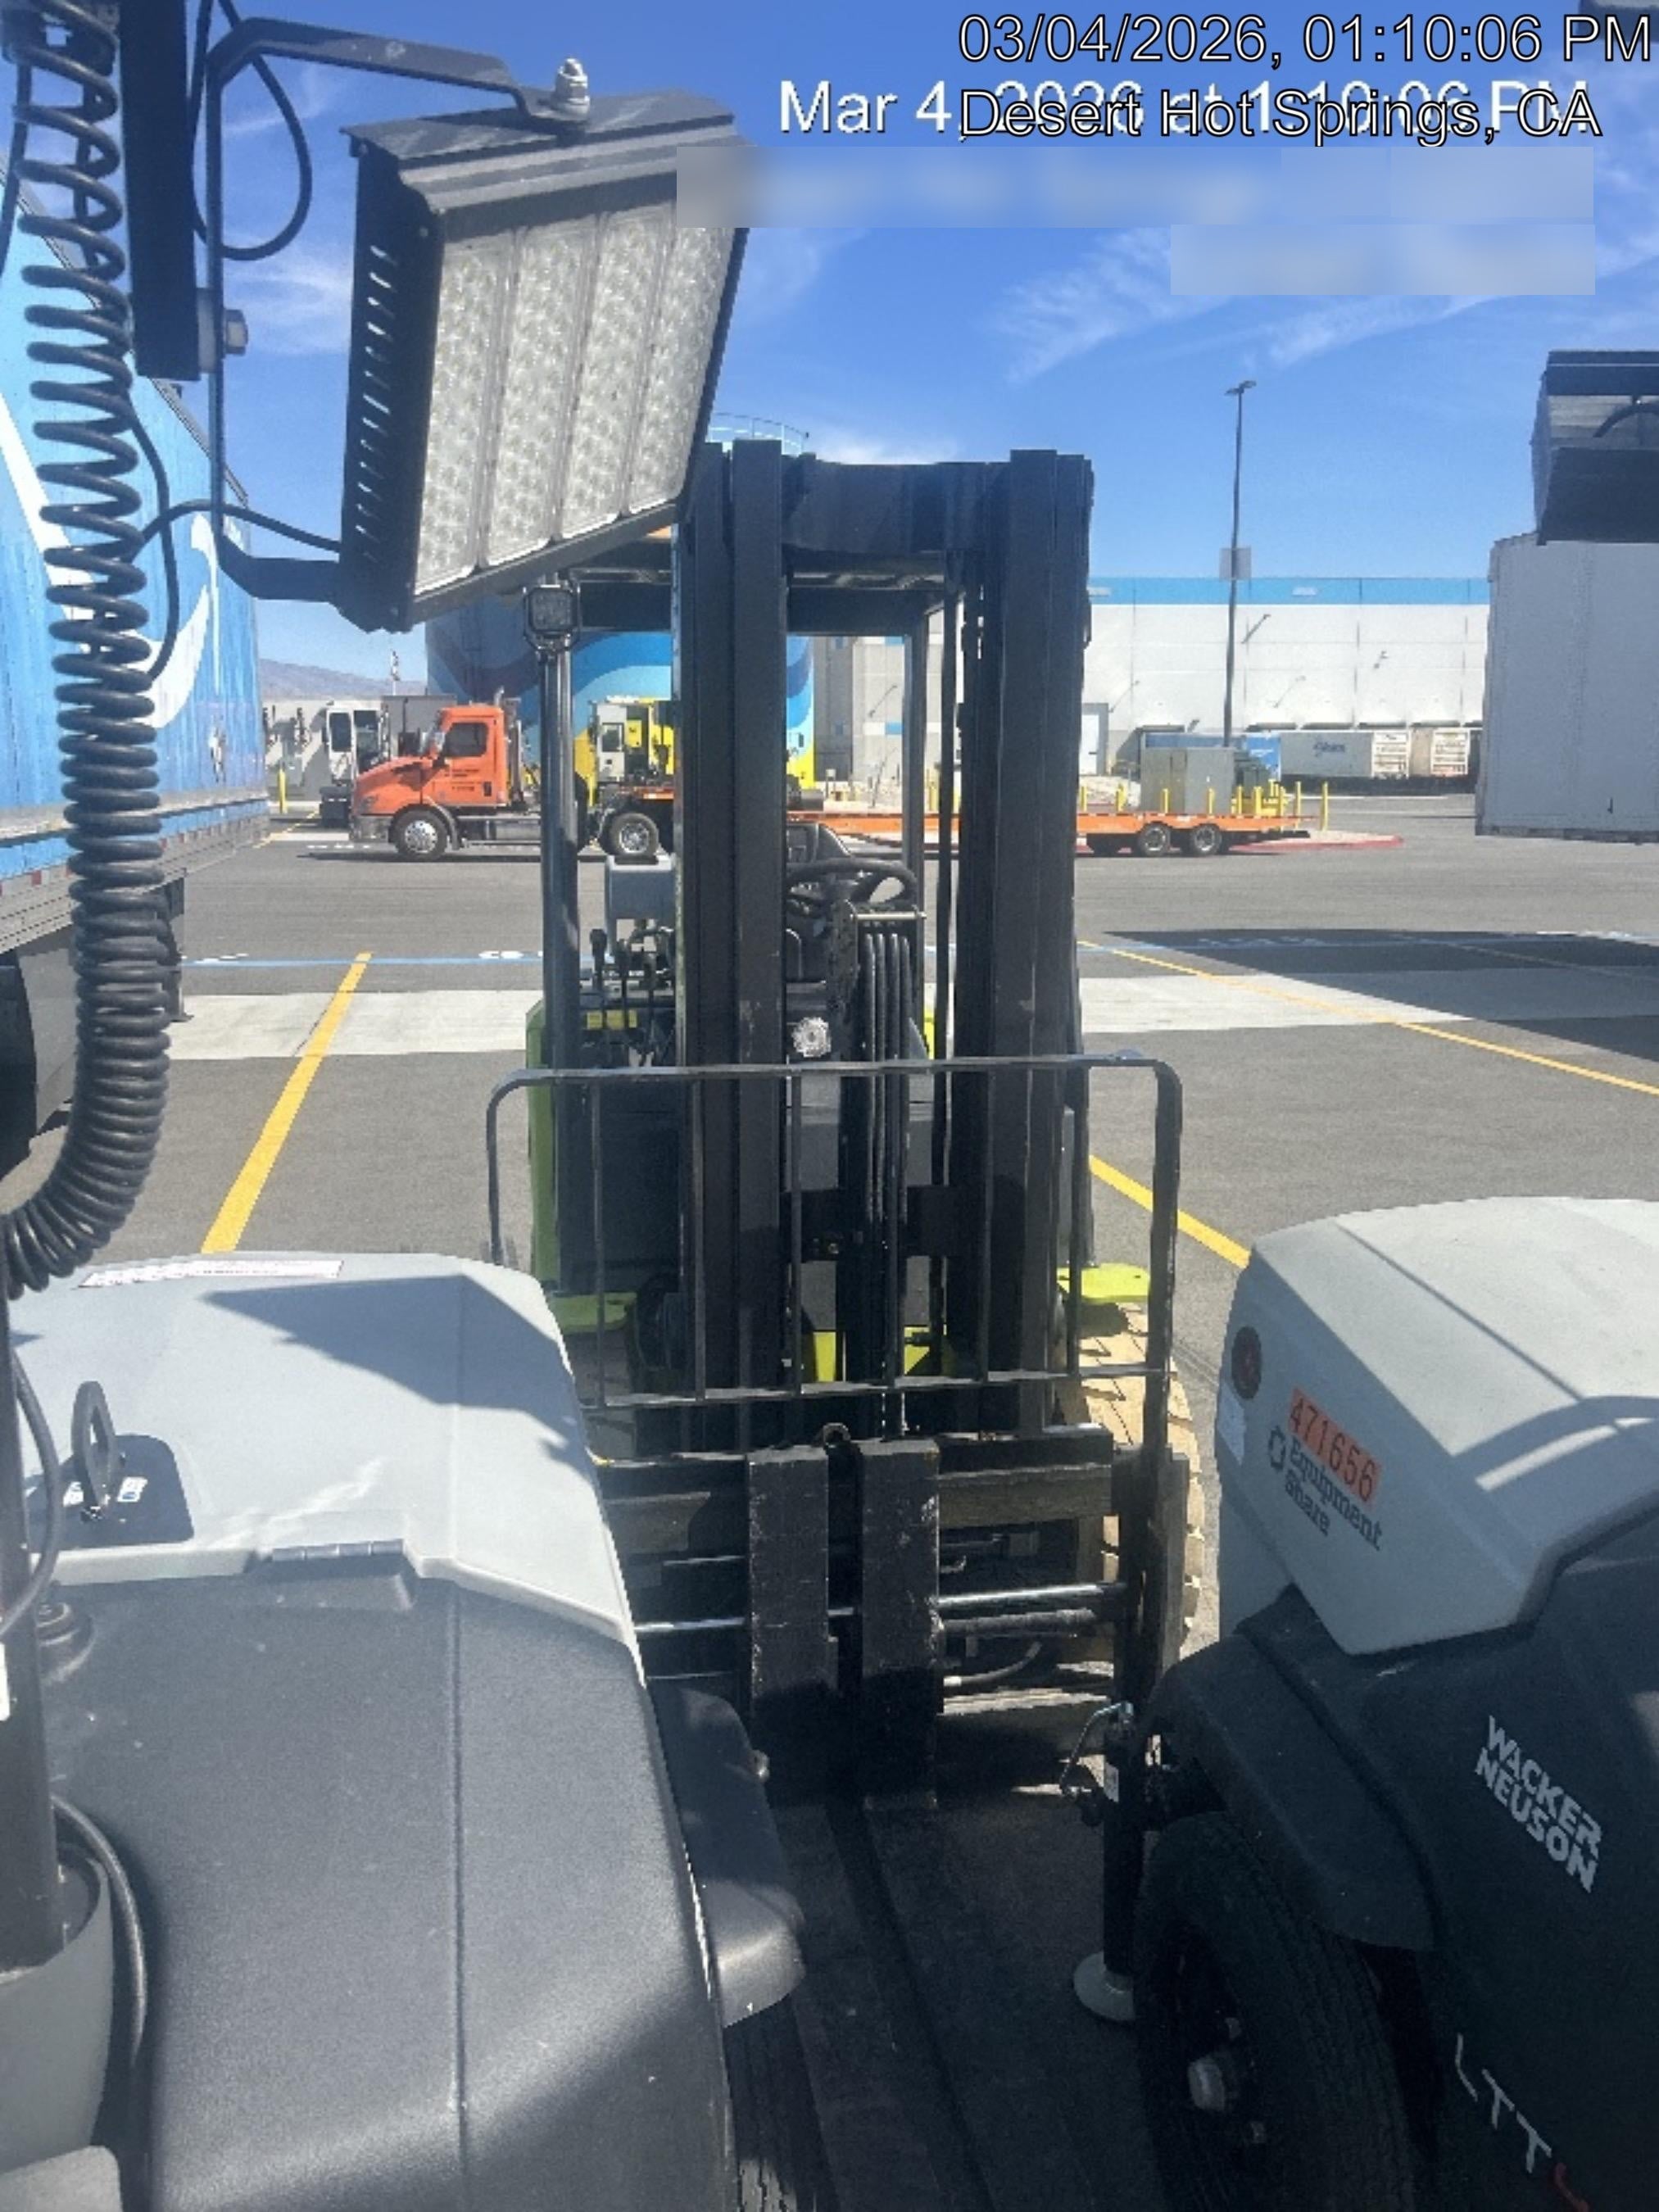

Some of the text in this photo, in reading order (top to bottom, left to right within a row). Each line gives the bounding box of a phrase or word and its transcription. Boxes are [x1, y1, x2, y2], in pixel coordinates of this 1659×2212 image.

[1290, 1397, 1377, 1503] 471656
[1290, 1435, 1383, 1550] Equipment
[1475, 1746, 1598, 1893] NEUSON
[1488, 1715, 1602, 1861] WACKER
